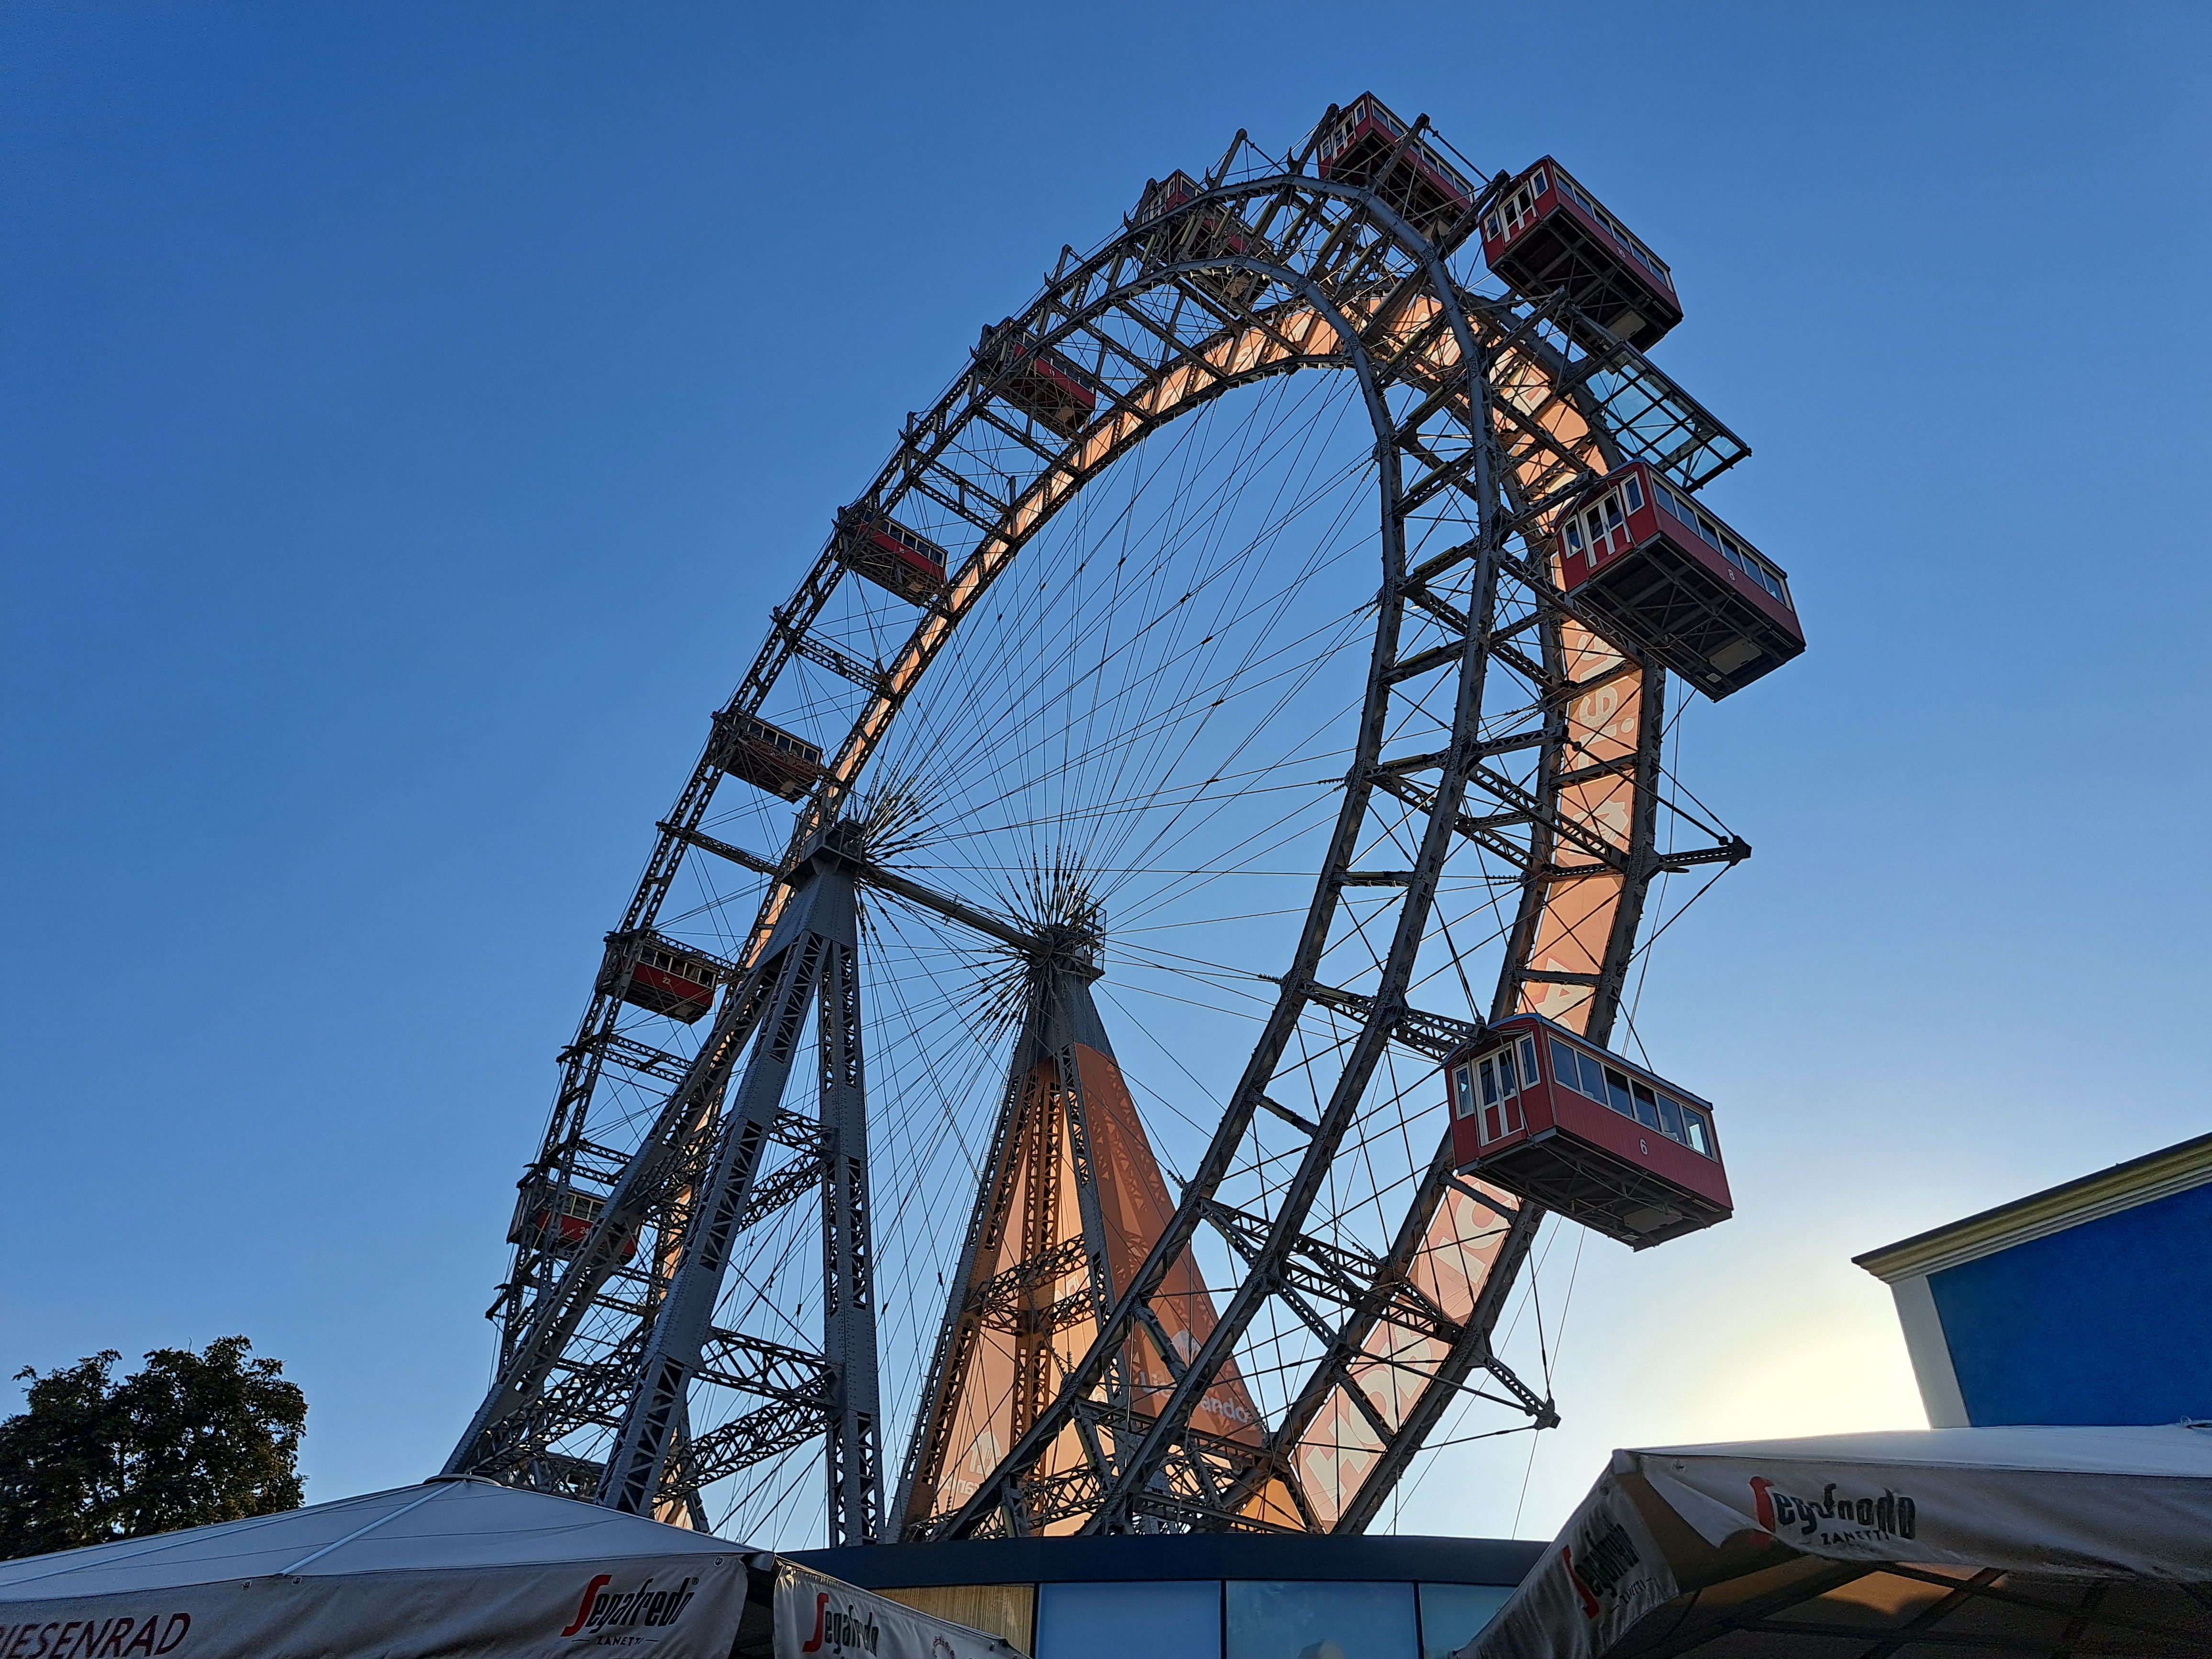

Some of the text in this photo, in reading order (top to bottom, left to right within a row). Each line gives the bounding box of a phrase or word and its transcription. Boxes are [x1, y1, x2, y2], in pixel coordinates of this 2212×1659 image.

[1423, 165, 1430, 176] 12
[1616, 246, 1626, 258] 10
[1727, 568, 1736, 581] 8
[662, 977, 671, 985] 22
[1640, 1139, 1648, 1155] 6
